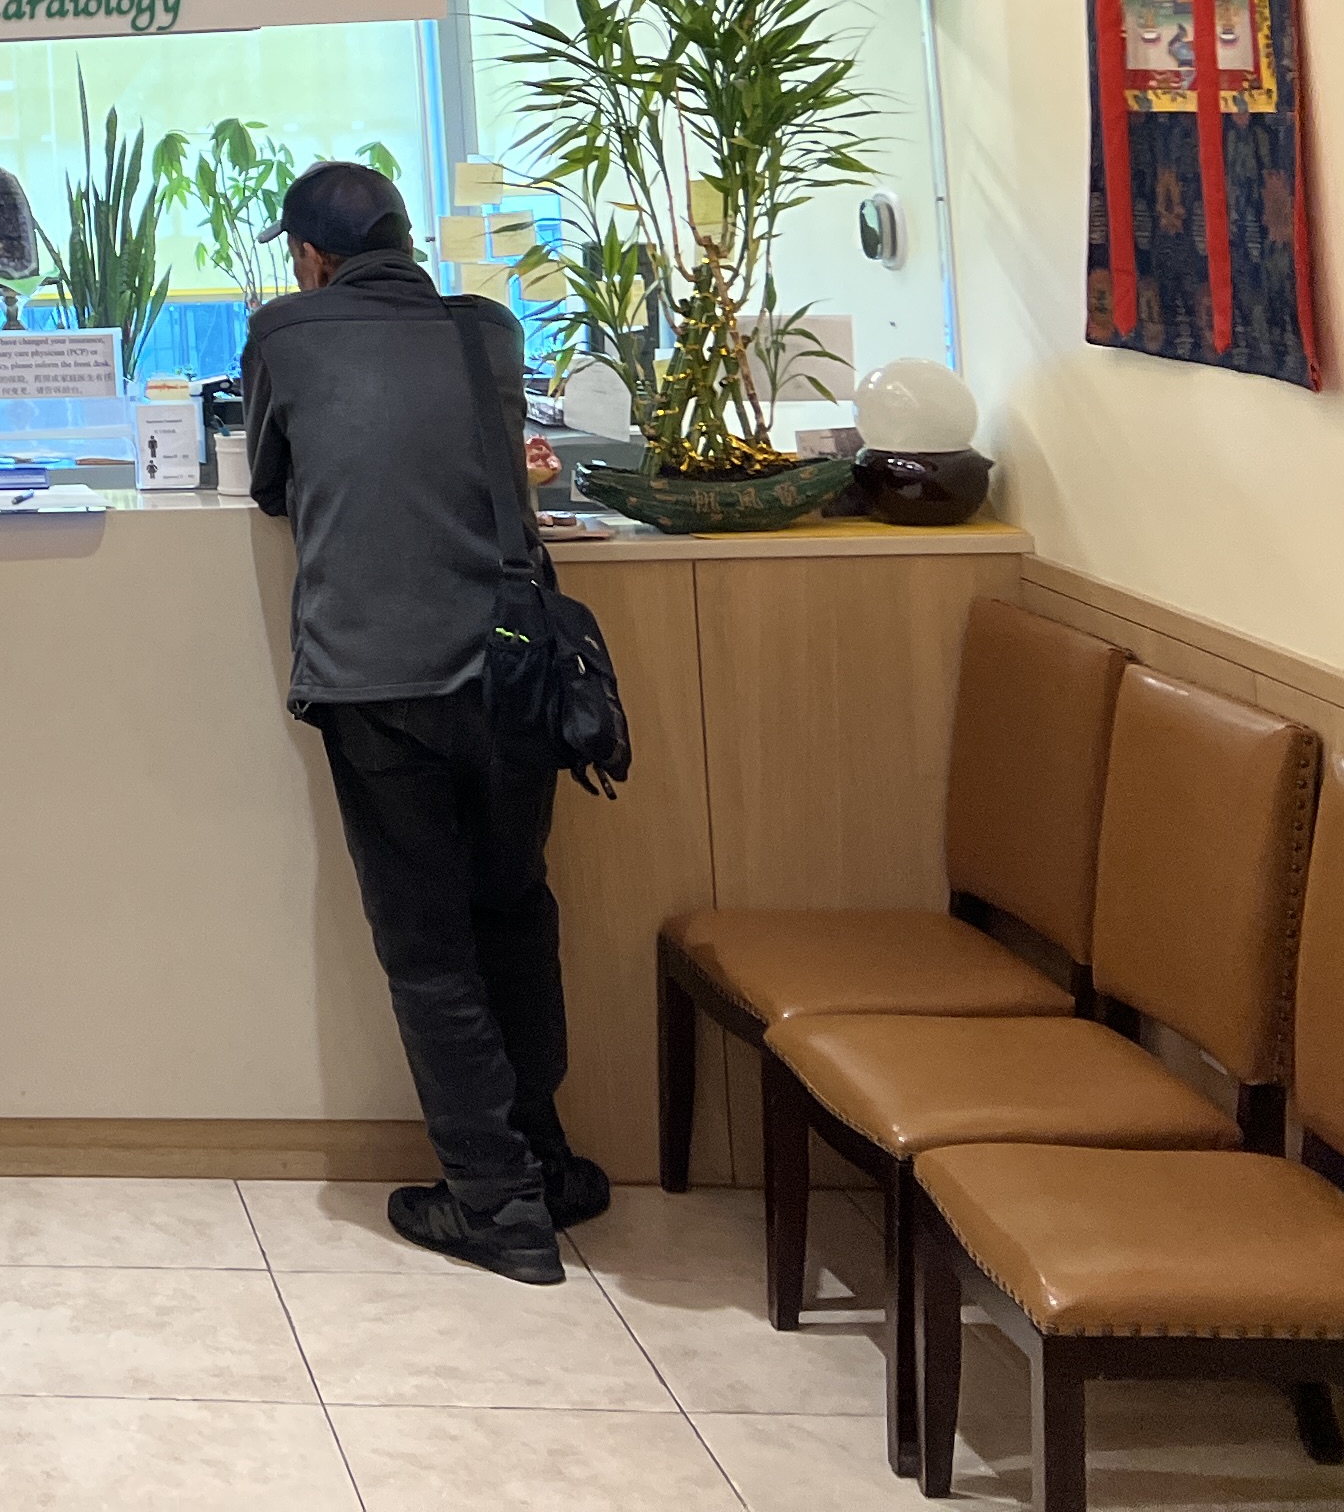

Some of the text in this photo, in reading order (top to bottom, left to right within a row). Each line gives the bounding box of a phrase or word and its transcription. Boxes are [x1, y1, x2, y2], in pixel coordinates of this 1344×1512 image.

[18, 338, 48, 346] changed
[67, 348, 89, 356] (PCP)
[11, 362, 33, 370] please
[61, 360, 72, 368] the
